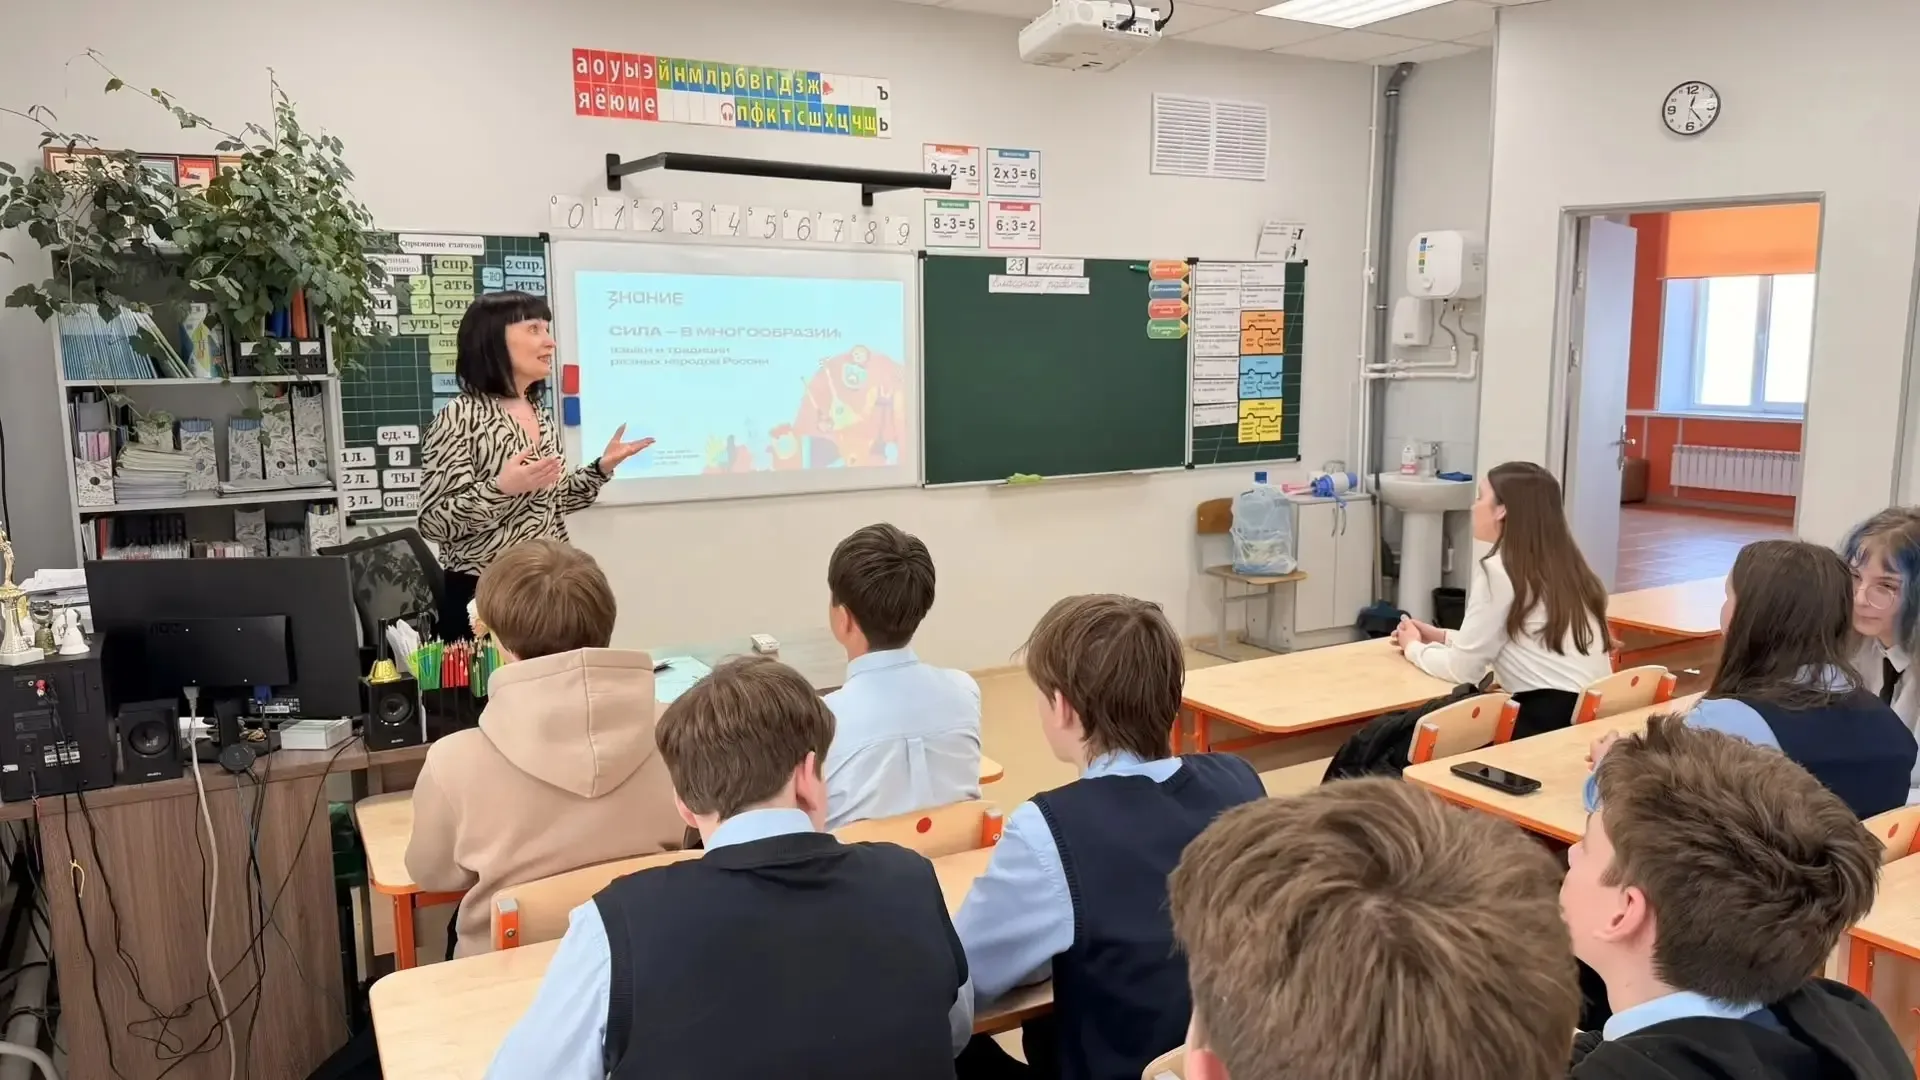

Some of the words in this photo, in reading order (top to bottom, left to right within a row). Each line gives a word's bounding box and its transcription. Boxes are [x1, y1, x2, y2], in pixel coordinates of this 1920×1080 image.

[1686, 85, 1699, 95] 12
[1668, 106, 1676, 115] 9
[1686, 122, 1694, 131] 6
[931, 163, 938, 174] 3
[940, 164, 948, 172] +
[950, 164, 957, 176] 2
[970, 165, 976, 176] 5
[994, 167, 1000, 179] 2
[1012, 168, 1018, 180] 3
[1030, 168, 1036, 180] 6
[568, 203, 584, 229] 0
[614, 204, 624, 230] 1
[651, 206, 664, 232] 2
[690, 209, 703, 234] 3
[729, 212, 740, 236] 4
[764, 214, 776, 239] 5
[797, 216, 811, 241] 6
[934, 217, 940, 229] 8
[950, 218, 956, 230] 3
[969, 218, 976, 230] 5
[996, 220, 1003, 231] 6
[1012, 220, 1018, 232] 3
[1030, 220, 1036, 232] 2
[832, 219, 844, 242] 7
[864, 220, 878, 244] 8
[896, 222, 910, 246] 9
[442, 259, 473, 273] спр.
[516, 260, 542, 272] спр.
[1008, 258, 1024, 272] 23
[435, 280, 473, 290] -ать
[609, 325, 662, 337] СИЛА
[681, 326, 692, 338] В
[382, 431, 400, 442] ед.
[404, 430, 416, 440] ч.
[352, 452, 366, 462] л.
[342, 474, 351, 484] 2
[355, 474, 370, 484] л.
[348, 496, 356, 508] 3
[360, 494, 373, 504] л.
